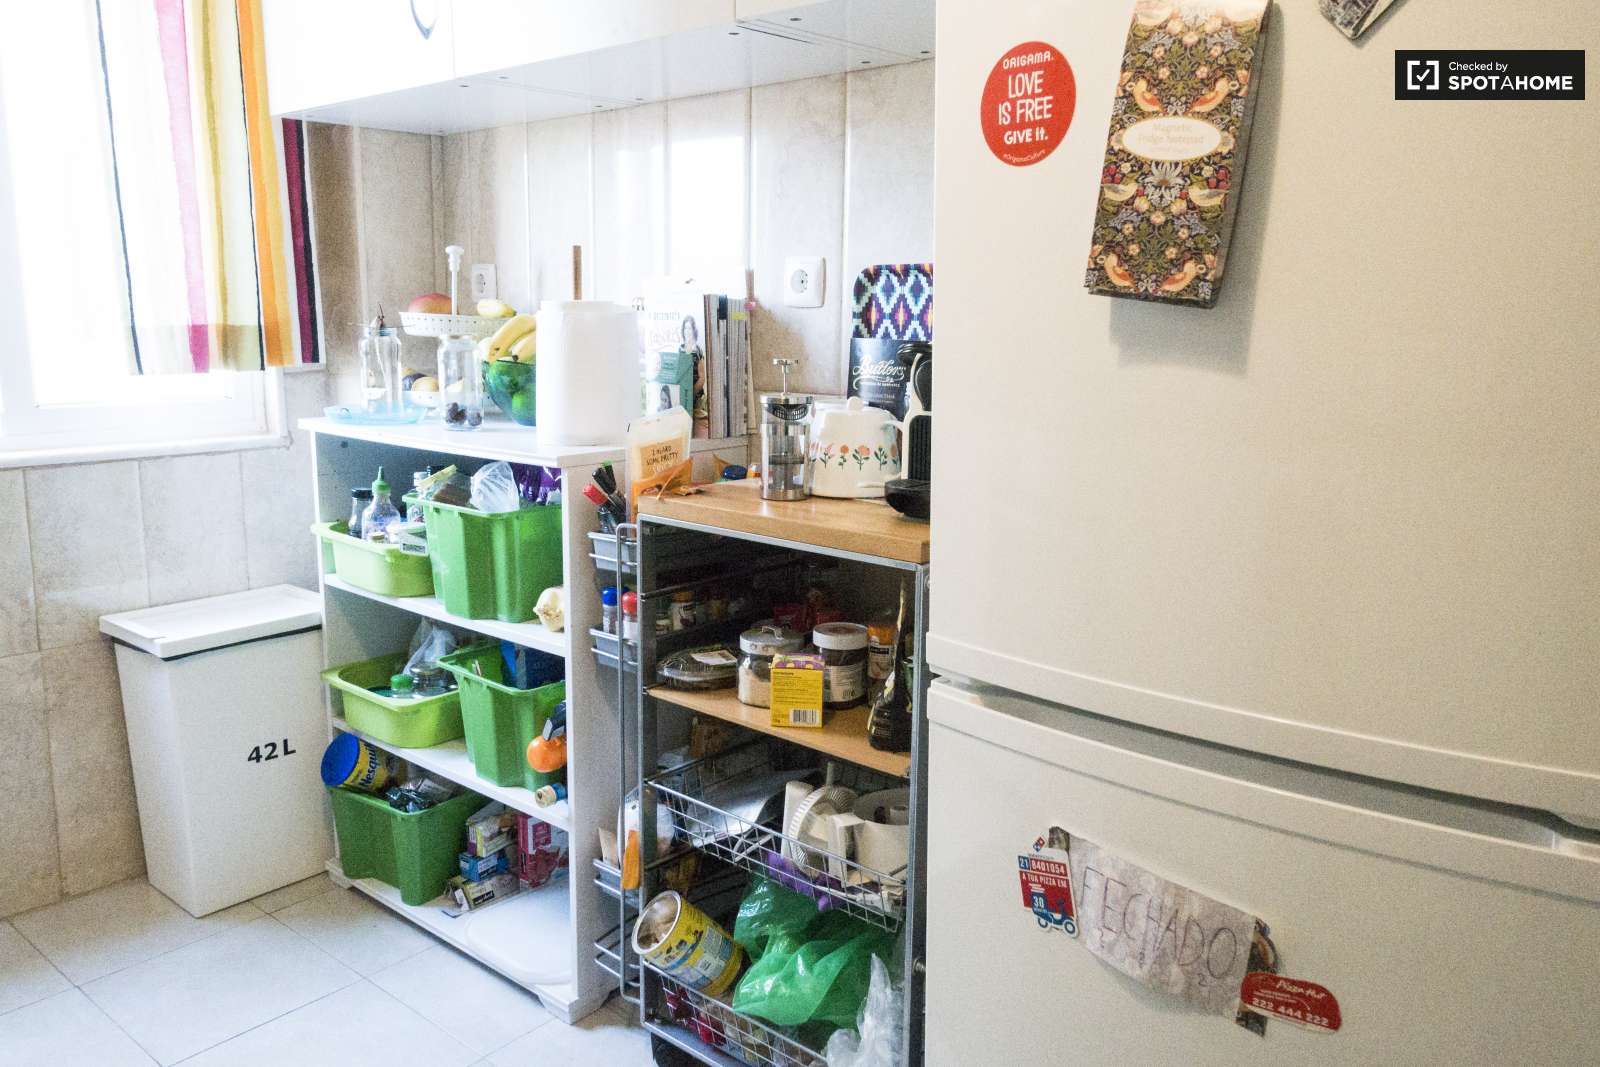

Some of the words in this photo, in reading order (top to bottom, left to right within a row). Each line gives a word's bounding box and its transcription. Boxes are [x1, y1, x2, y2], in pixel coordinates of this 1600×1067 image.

[1008, 70, 1044, 98] LOVE
[998, 101, 1012, 125] IS
[1016, 96, 1053, 123] FREE
[1004, 128, 1033, 144] GIVE
[1019, 857, 1029, 869] 21
[1022, 872, 1027, 880] A
[1039, 876, 1057, 886] PIZZA
[1033, 895, 1045, 909] 30
[1080, 866, 1237, 979] FECHADO
[1252, 997, 1274, 1010] 222
[1278, 1006, 1302, 1019] 444
[1305, 1013, 1329, 1026] 222
